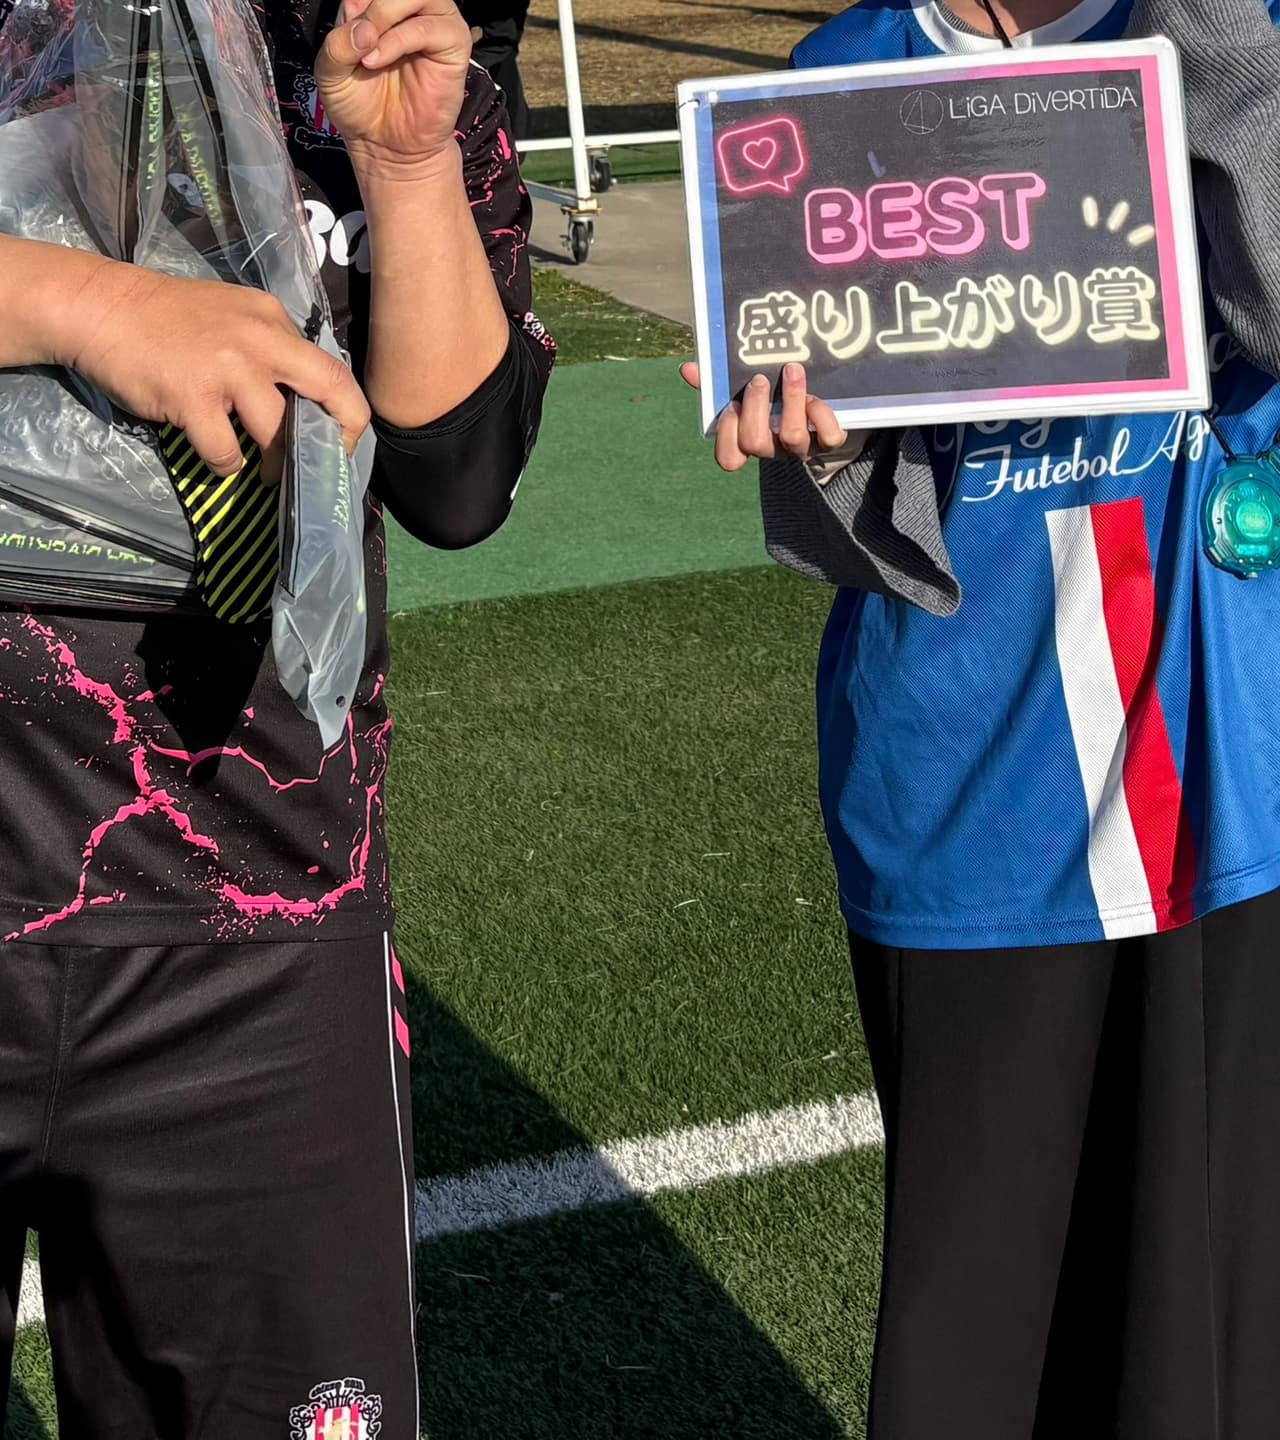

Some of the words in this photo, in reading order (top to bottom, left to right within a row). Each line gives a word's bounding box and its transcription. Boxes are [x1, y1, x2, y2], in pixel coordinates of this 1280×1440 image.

[803, 172, 1047, 266] BEST
[736, 266, 1161, 367] 盛り上がり賞
[961, 427, 1132, 503] Futebol
